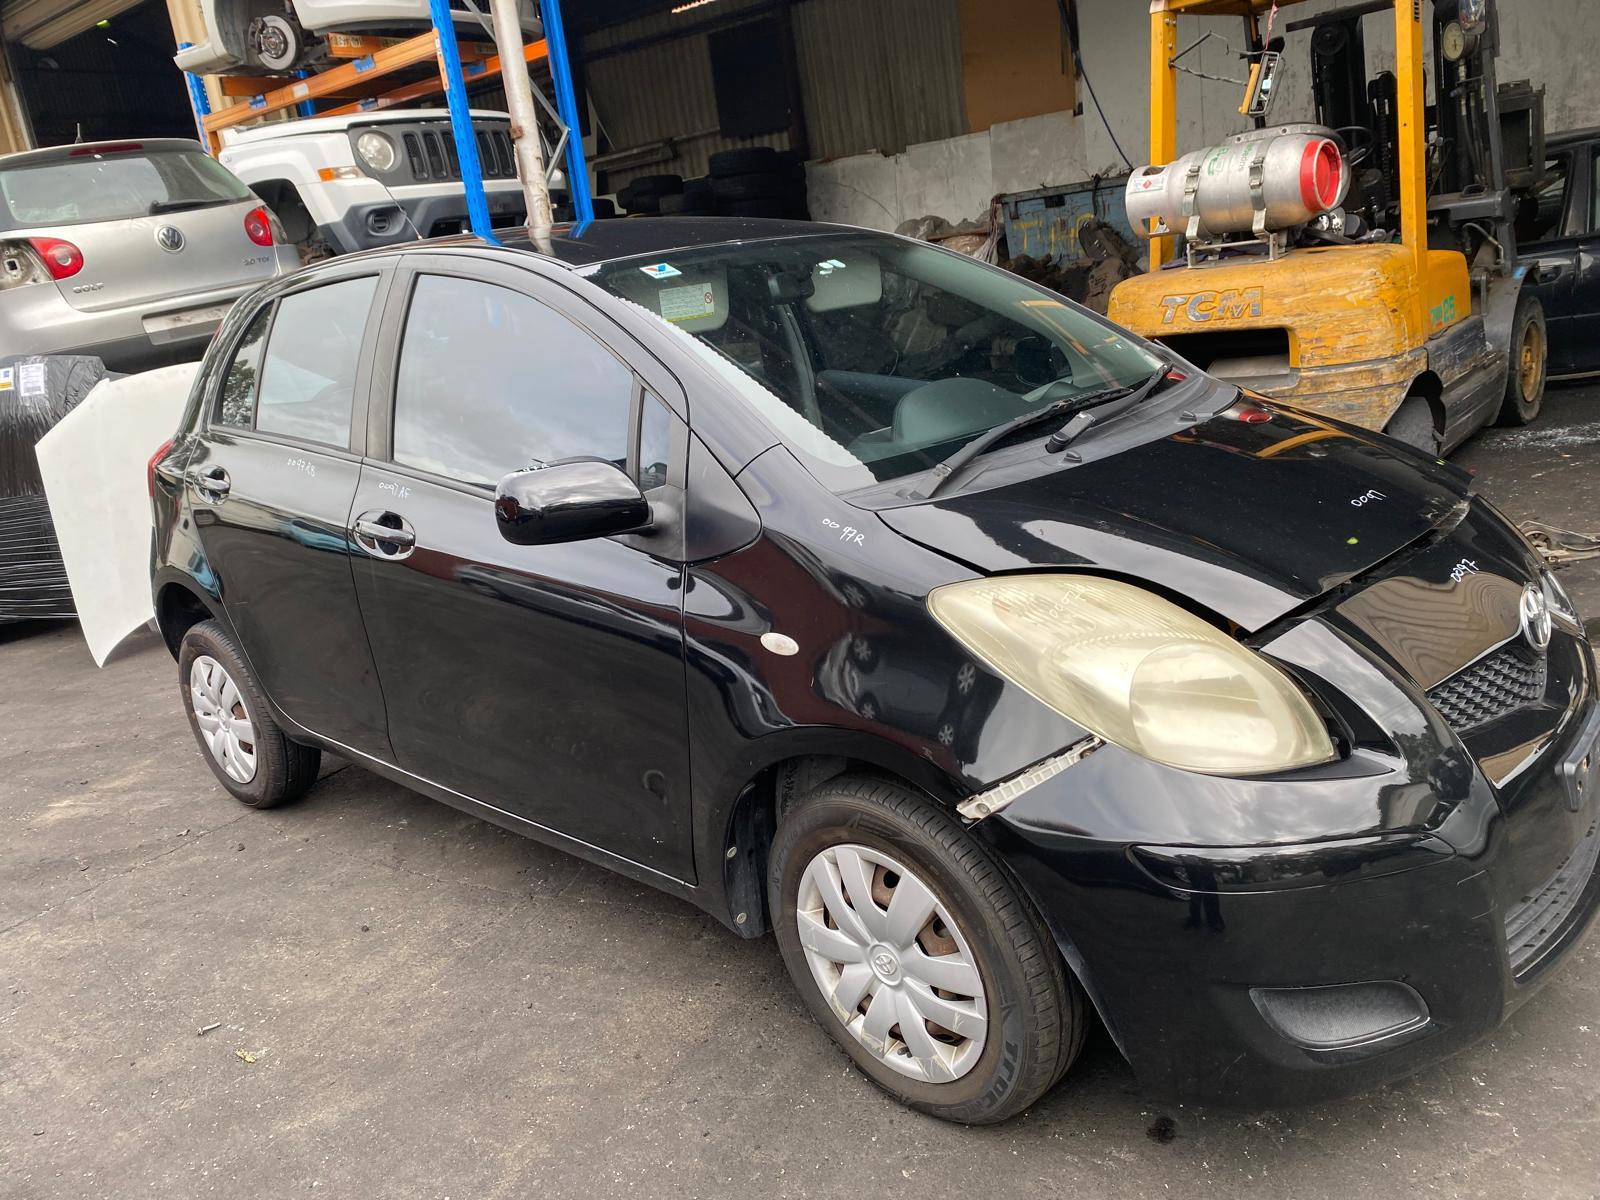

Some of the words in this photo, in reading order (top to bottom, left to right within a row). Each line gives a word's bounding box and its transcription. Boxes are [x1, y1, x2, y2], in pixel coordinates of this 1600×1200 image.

[72, 282, 105, 294] GOLF
[1159, 286, 1264, 324] TCM
[1350, 489, 1387, 507] 0097
[1450, 558, 1480, 583] 0097
